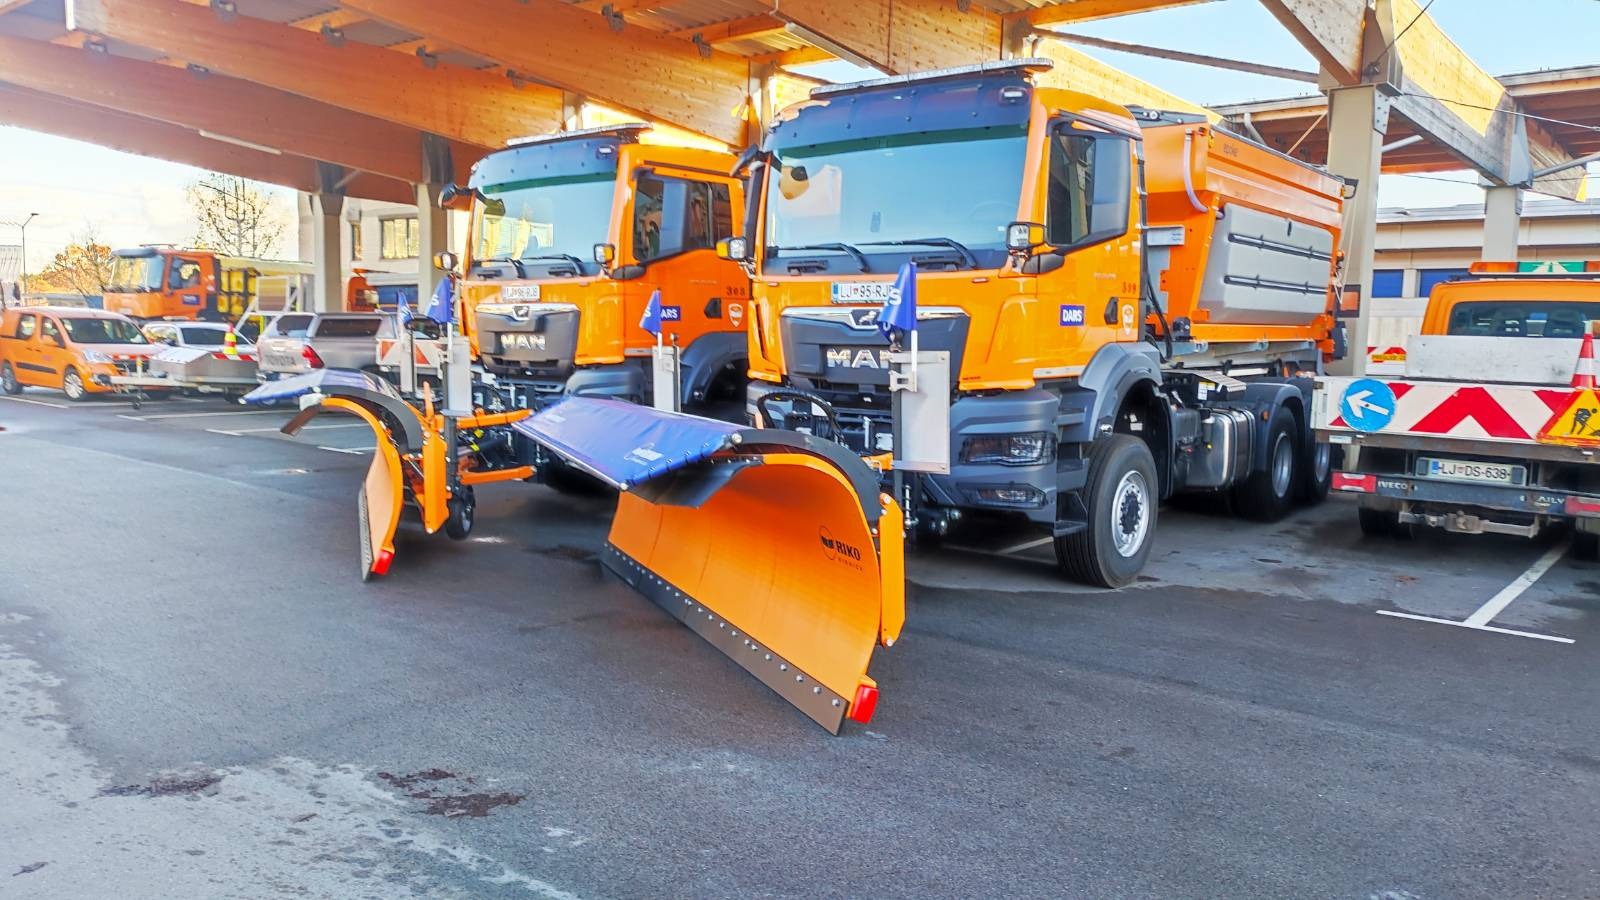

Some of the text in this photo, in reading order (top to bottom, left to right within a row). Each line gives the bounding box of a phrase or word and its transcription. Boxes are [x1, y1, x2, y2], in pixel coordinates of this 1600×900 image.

[660, 308, 678, 319] ARS
[1062, 309, 1083, 322] DARS
[500, 334, 546, 351] MAN
[1441, 463, 1457, 475] LJ
[1377, 480, 1408, 490] IVECO
[835, 540, 861, 561] RIKO
